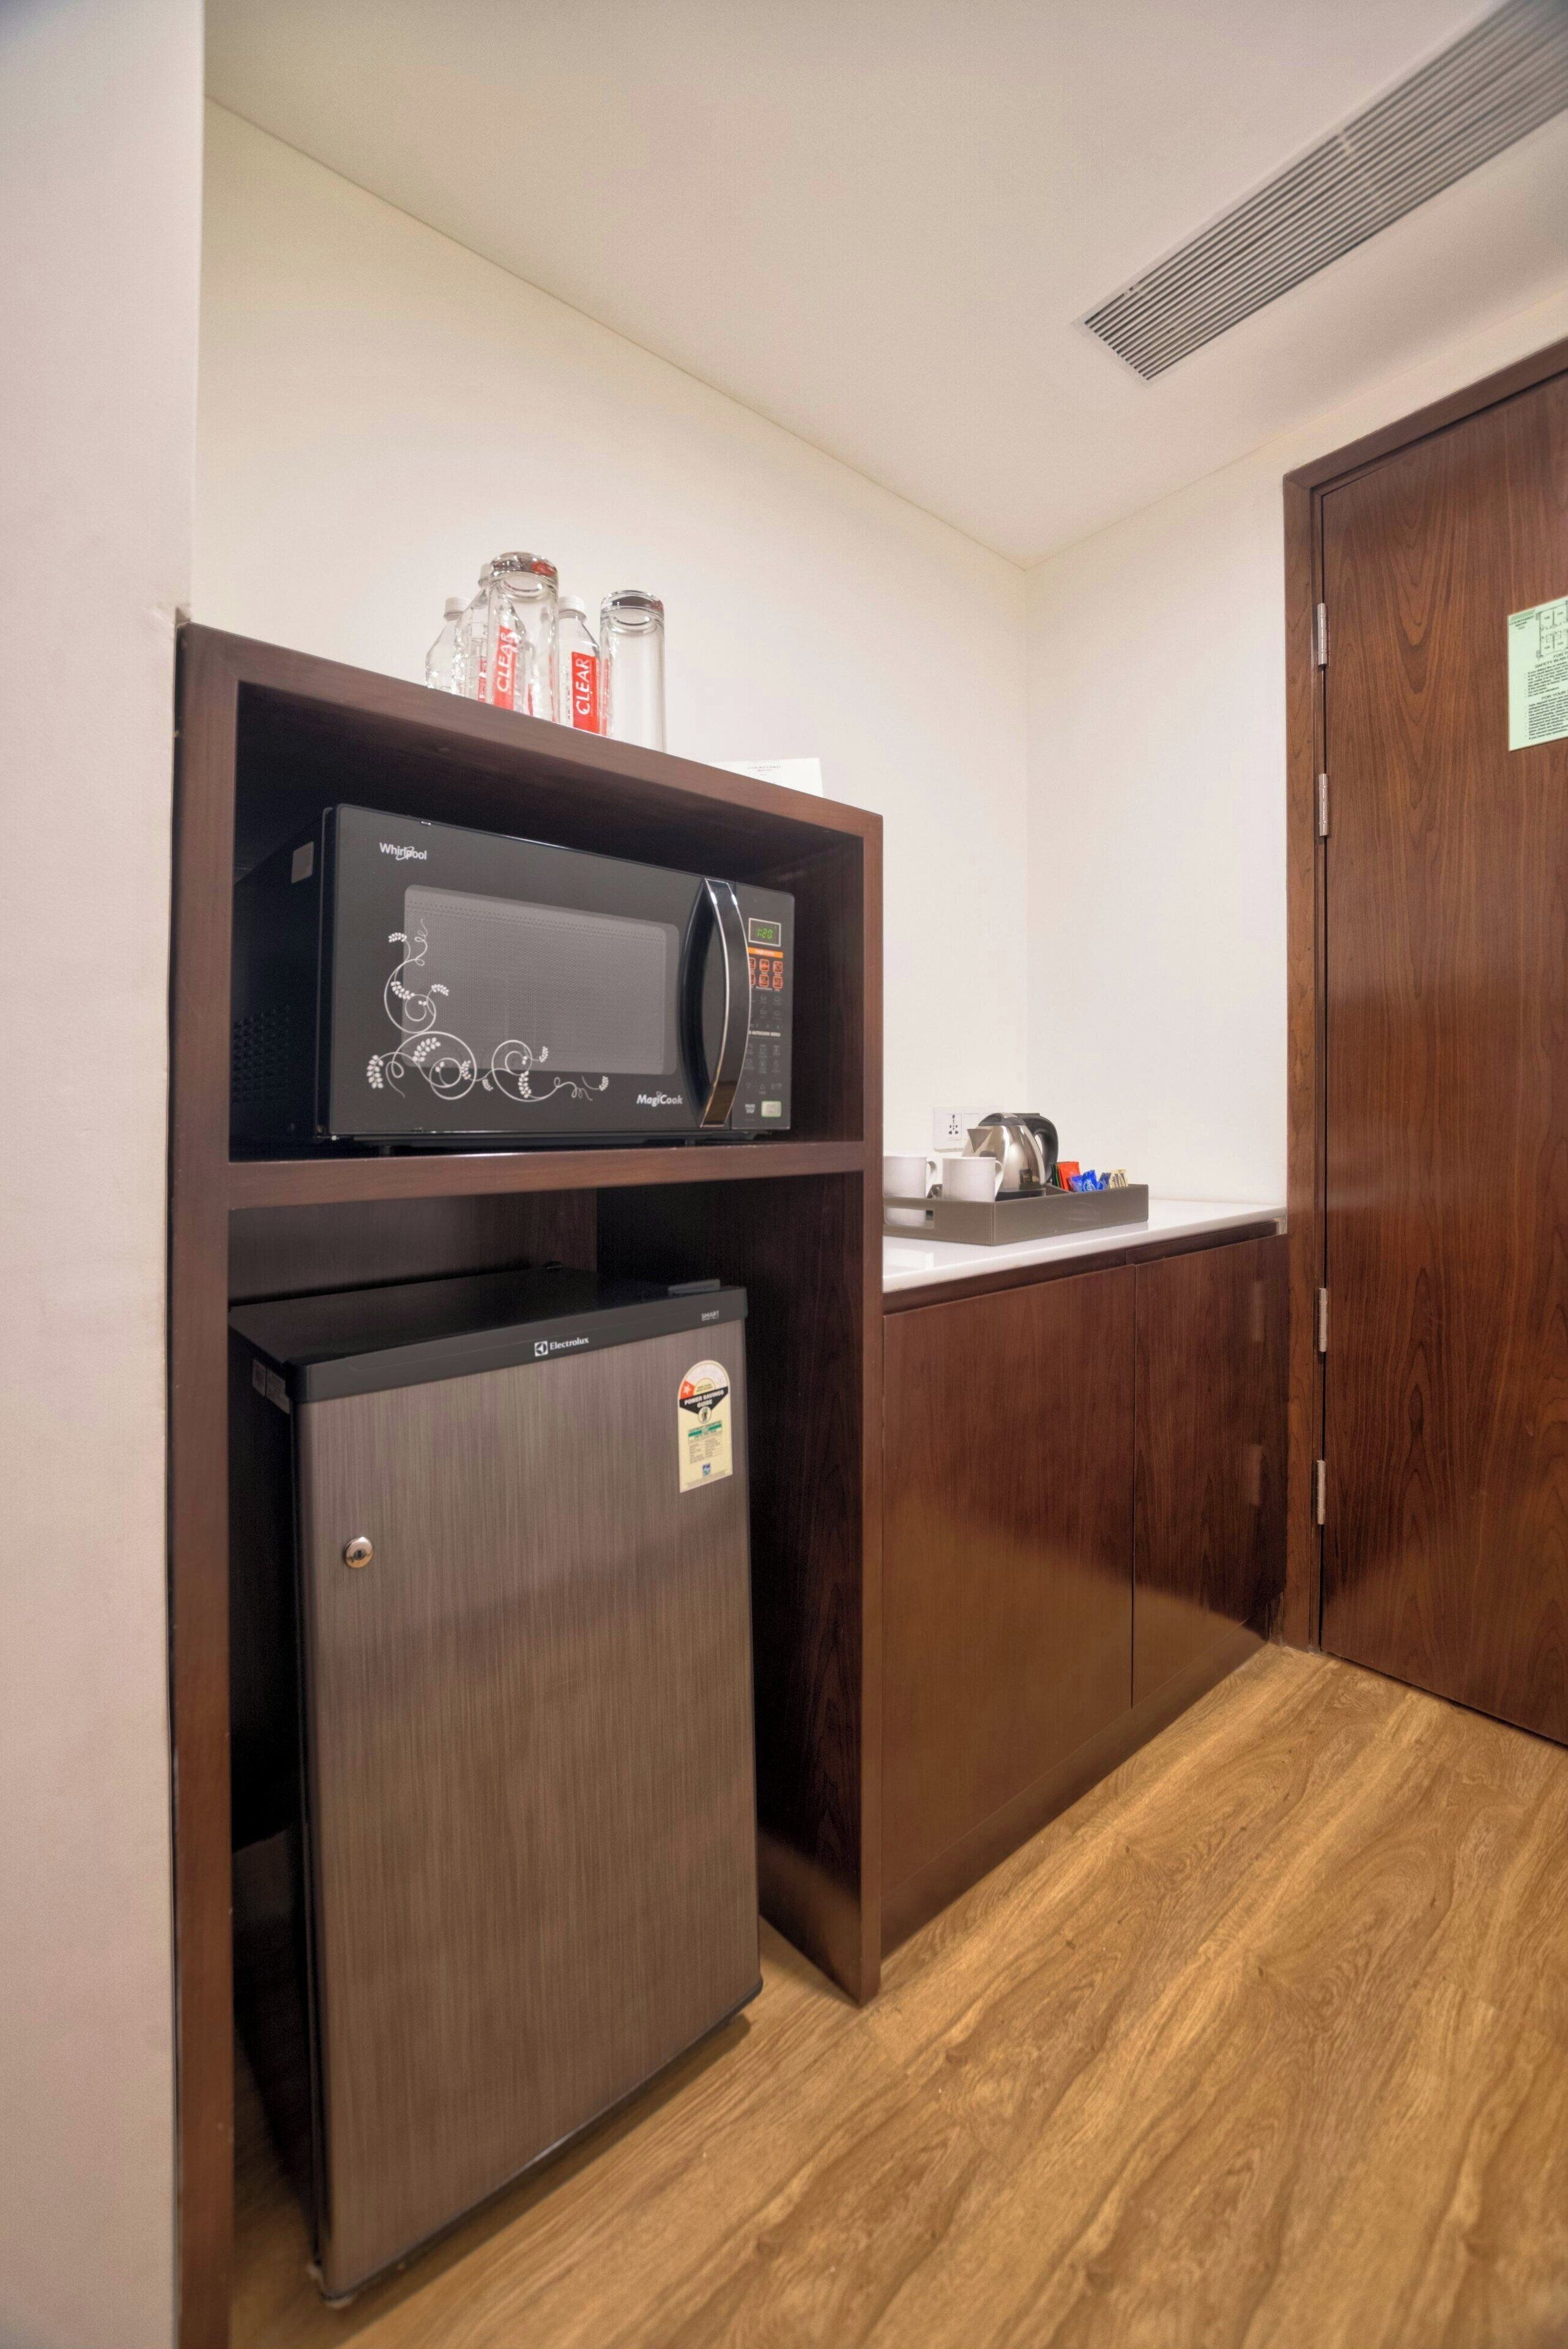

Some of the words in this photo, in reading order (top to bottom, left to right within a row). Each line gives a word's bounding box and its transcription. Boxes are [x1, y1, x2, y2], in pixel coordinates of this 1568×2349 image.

[575, 658, 591, 715] CLEAR
[379, 842, 428, 861] Whirlpool
[636, 1091, 683, 1107] MagiCook
[549, 1337, 590, 1351] Electrolux
